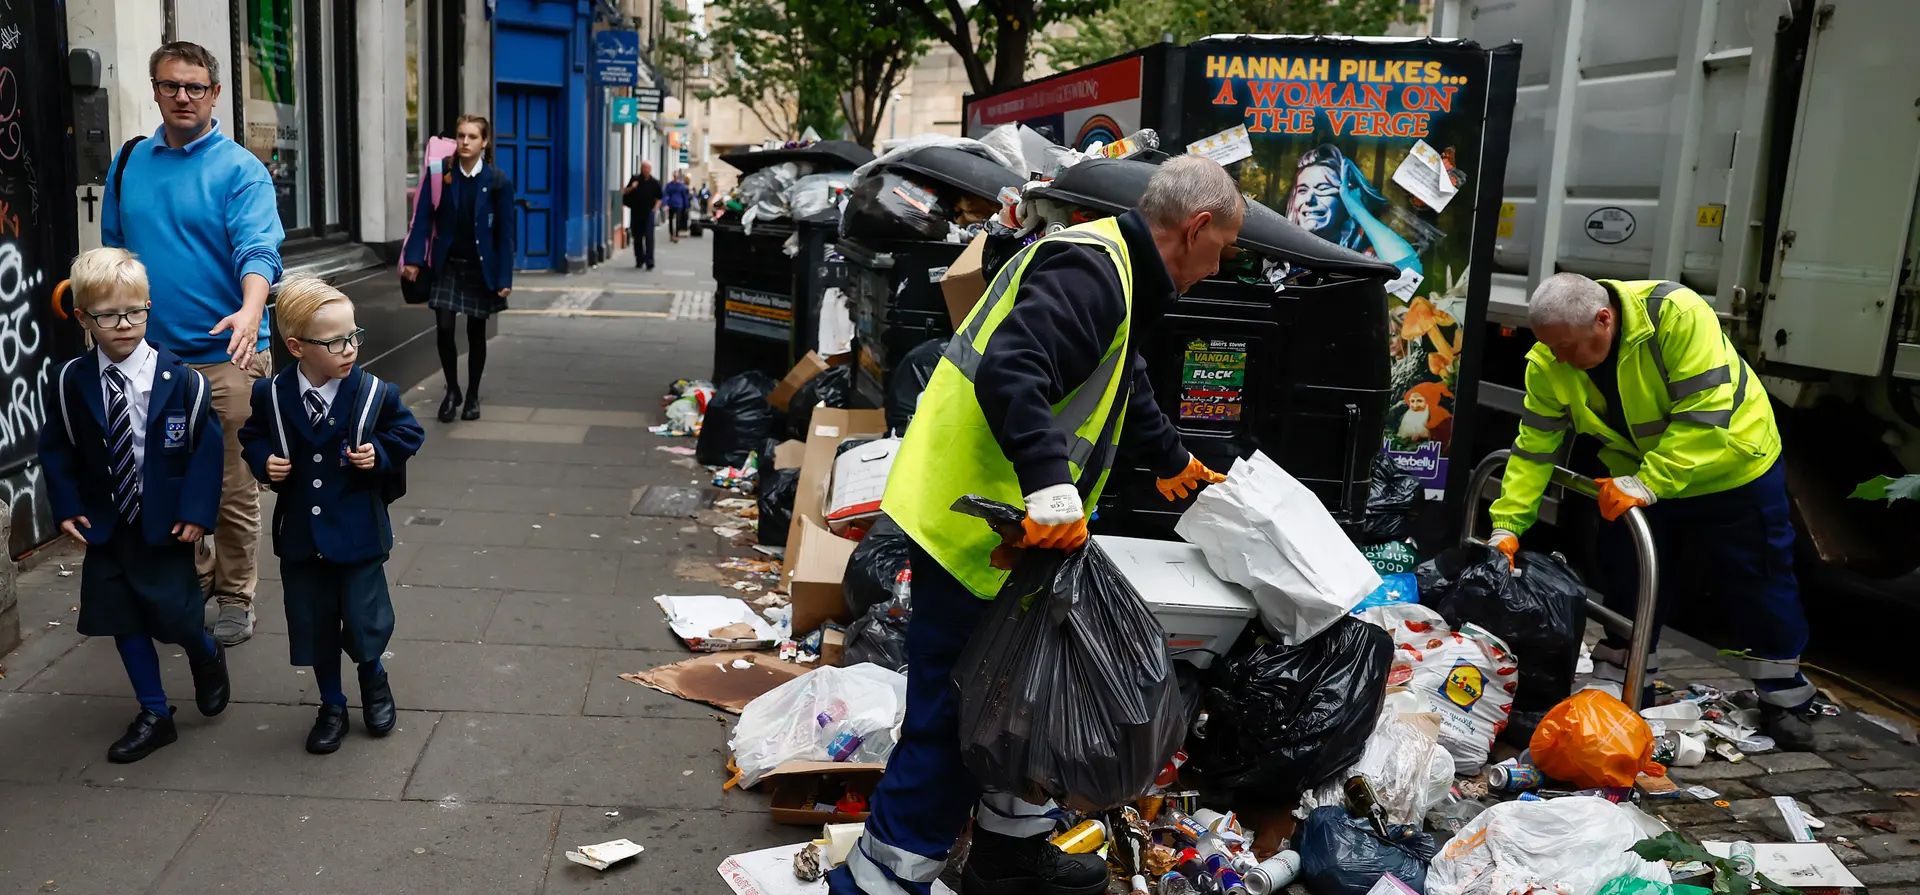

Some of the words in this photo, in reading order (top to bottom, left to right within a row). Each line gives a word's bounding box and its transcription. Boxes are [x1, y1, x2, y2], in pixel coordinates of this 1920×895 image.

[1206, 55, 1330, 80] HANNAH
[1339, 59, 1468, 85] PILKES...
[1212, 79, 1238, 105] A
[1247, 81, 1393, 111] WOMAN
[1401, 86, 1458, 113] ON
[1244, 107, 1315, 134] THE
[1326, 110, 1431, 137] VERGE
[1394, 455, 1436, 470] derbelly
[1362, 542, 1392, 552] THIS
[1396, 542, 1407, 552] IS
[1363, 551, 1383, 559] OT
